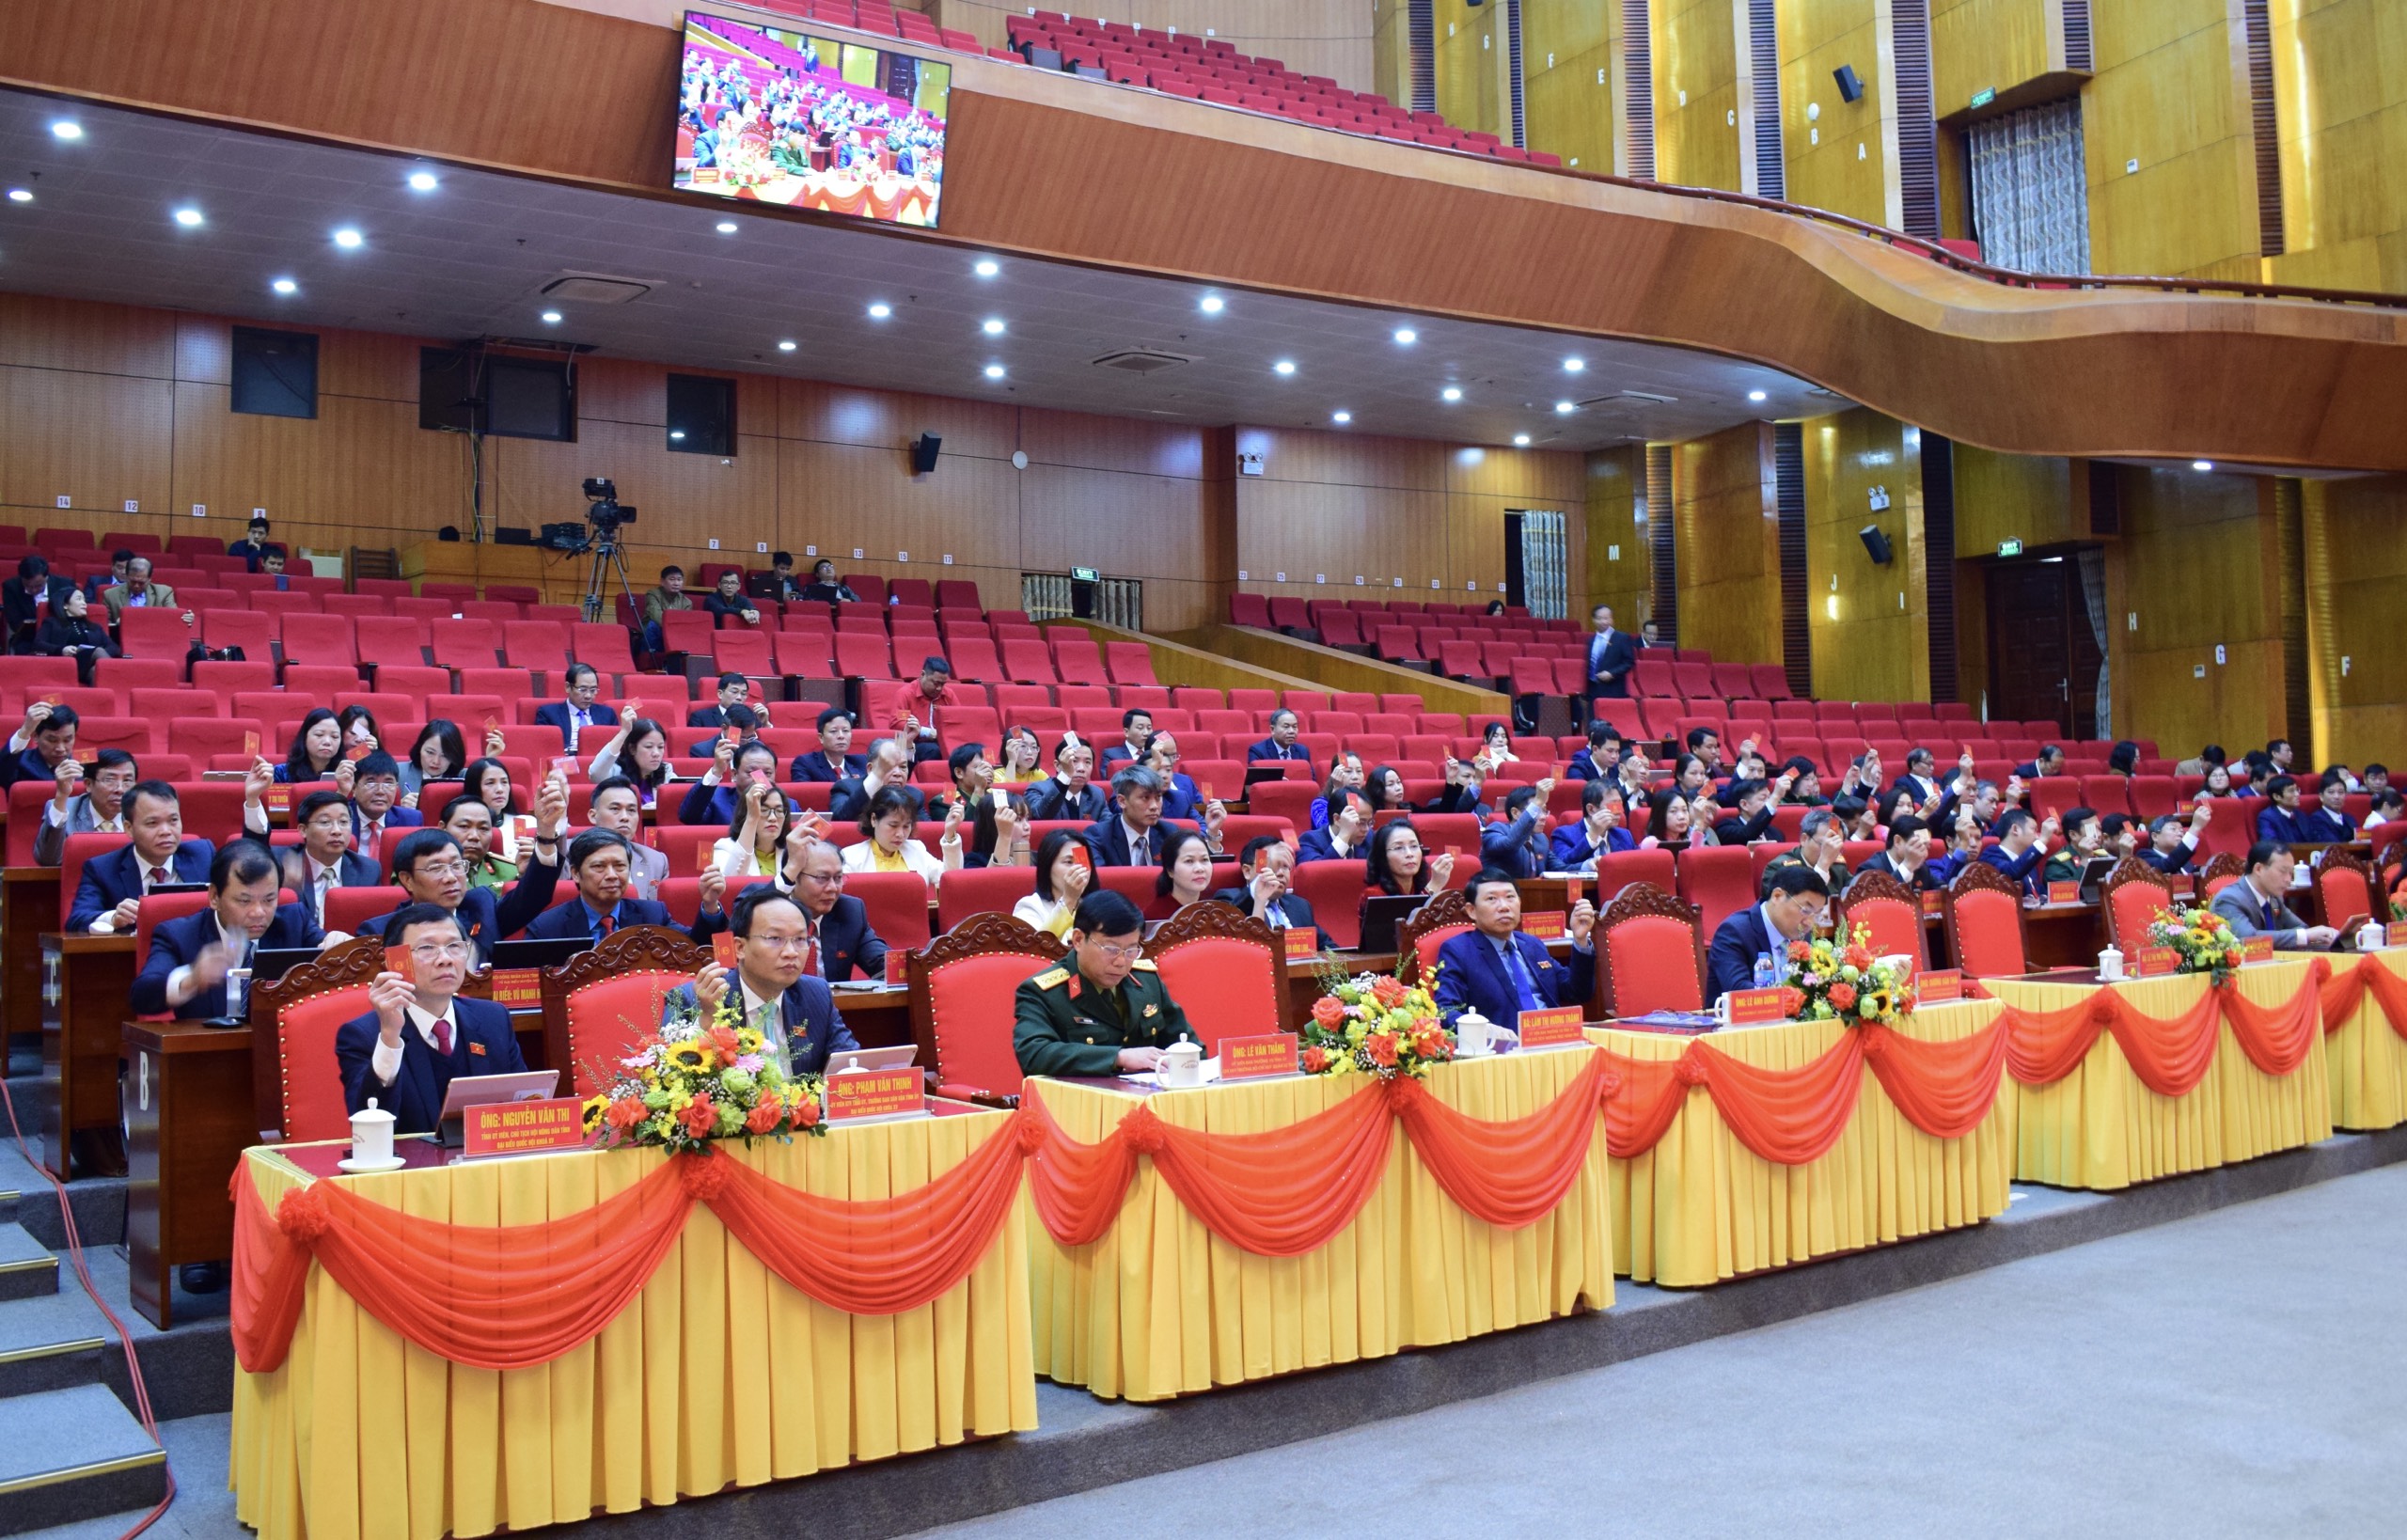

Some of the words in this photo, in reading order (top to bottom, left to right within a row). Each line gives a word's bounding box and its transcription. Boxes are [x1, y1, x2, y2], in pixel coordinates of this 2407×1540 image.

[1548, 53, 1553, 68] F
[1597, 68, 1605, 85] E
[1727, 110, 1735, 126] C
[1810, 128, 1818, 145] B
[1858, 143, 1866, 160] A
[1609, 545, 1619, 560] M
[1831, 574, 1837, 590] J
[2129, 612, 2137, 631] H
[2215, 644, 2226, 665] G
[2341, 656, 2351, 677] F
[50, 957, 56, 1007] C
[140, 1051, 149, 1110] B
[856, 1080, 876, 1096] PHẠM
[877, 1076, 891, 1092] VĂN
[892, 1076, 912, 1093] THỊNH
[480, 1111, 500, 1128] ÔNG:
[503, 1106, 536, 1127] NGUYỄN
[539, 1107, 555, 1123] VĂN
[557, 1108, 570, 1122] THI
